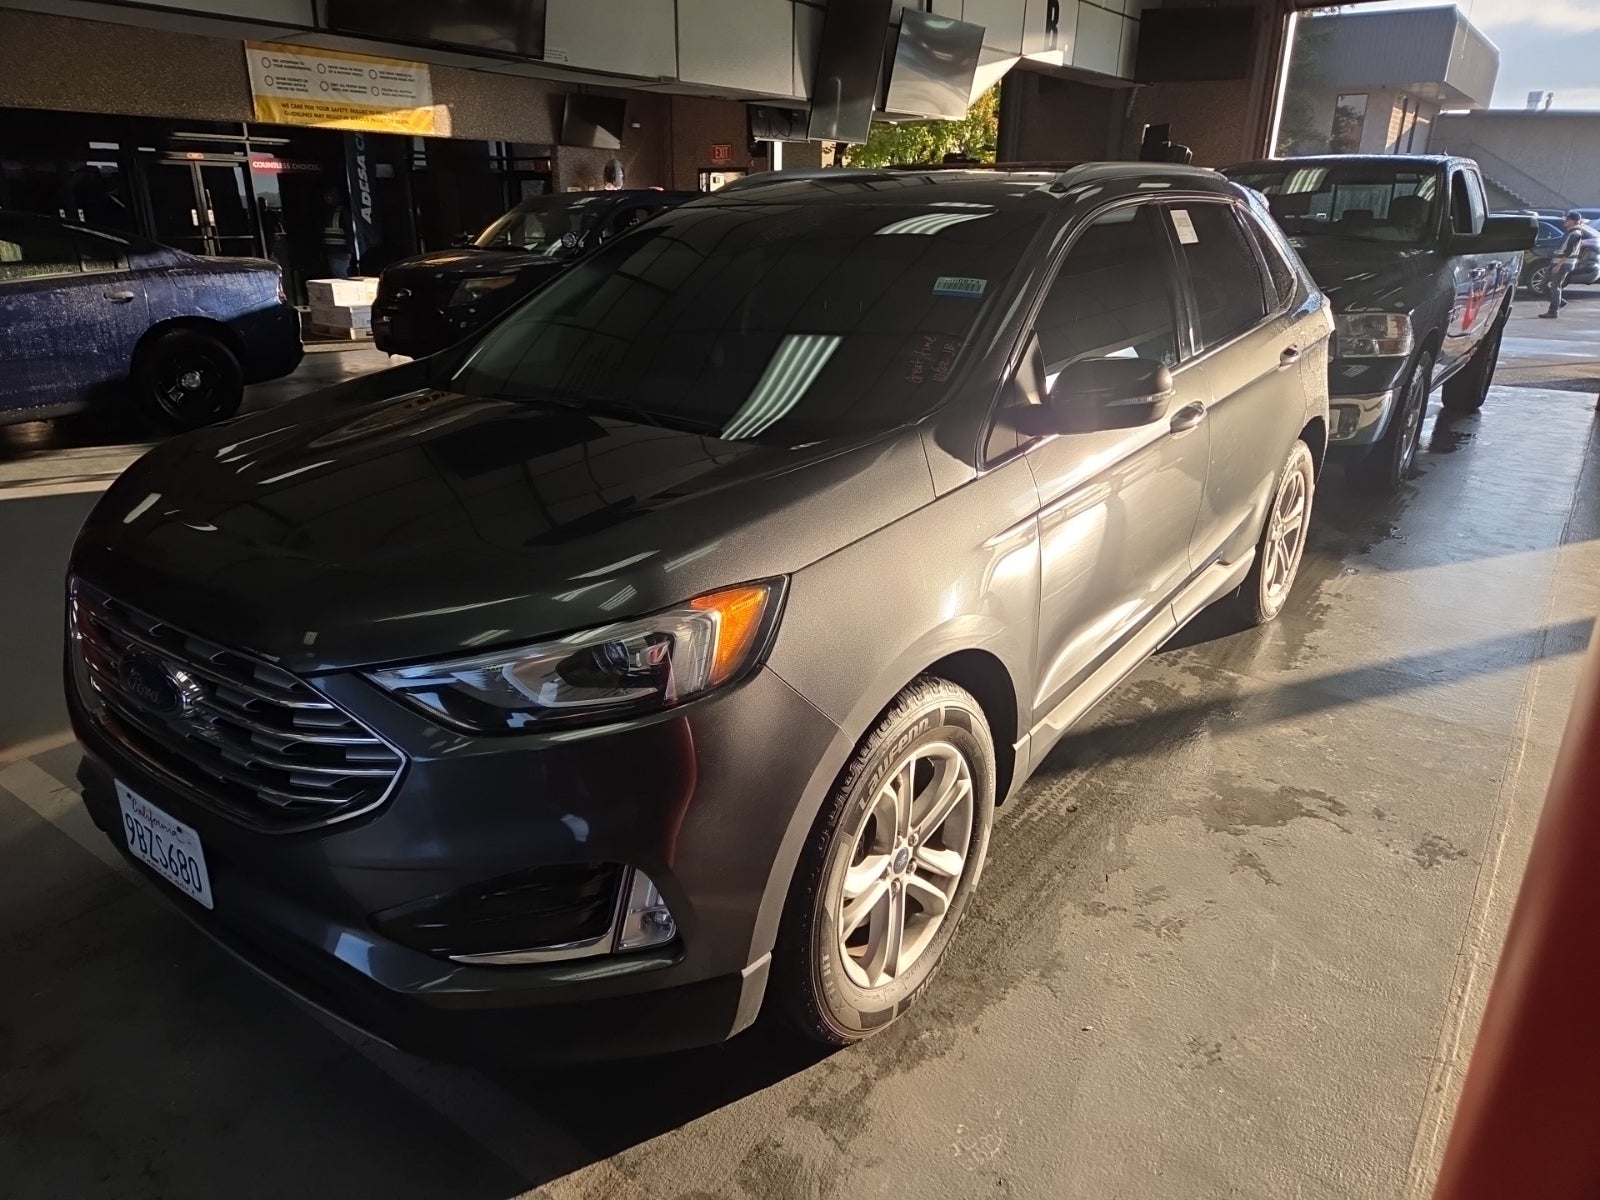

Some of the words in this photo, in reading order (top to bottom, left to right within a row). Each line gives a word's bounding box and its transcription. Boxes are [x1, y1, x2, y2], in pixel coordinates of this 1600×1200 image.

[252, 160, 291, 170] COUNTLESS
[714, 146, 730, 160] EXIT
[357, 155, 371, 224] ADESA
[127, 665, 164, 705] Ford
[131, 797, 178, 836] California
[124, 812, 203, 893] 9BZS680
